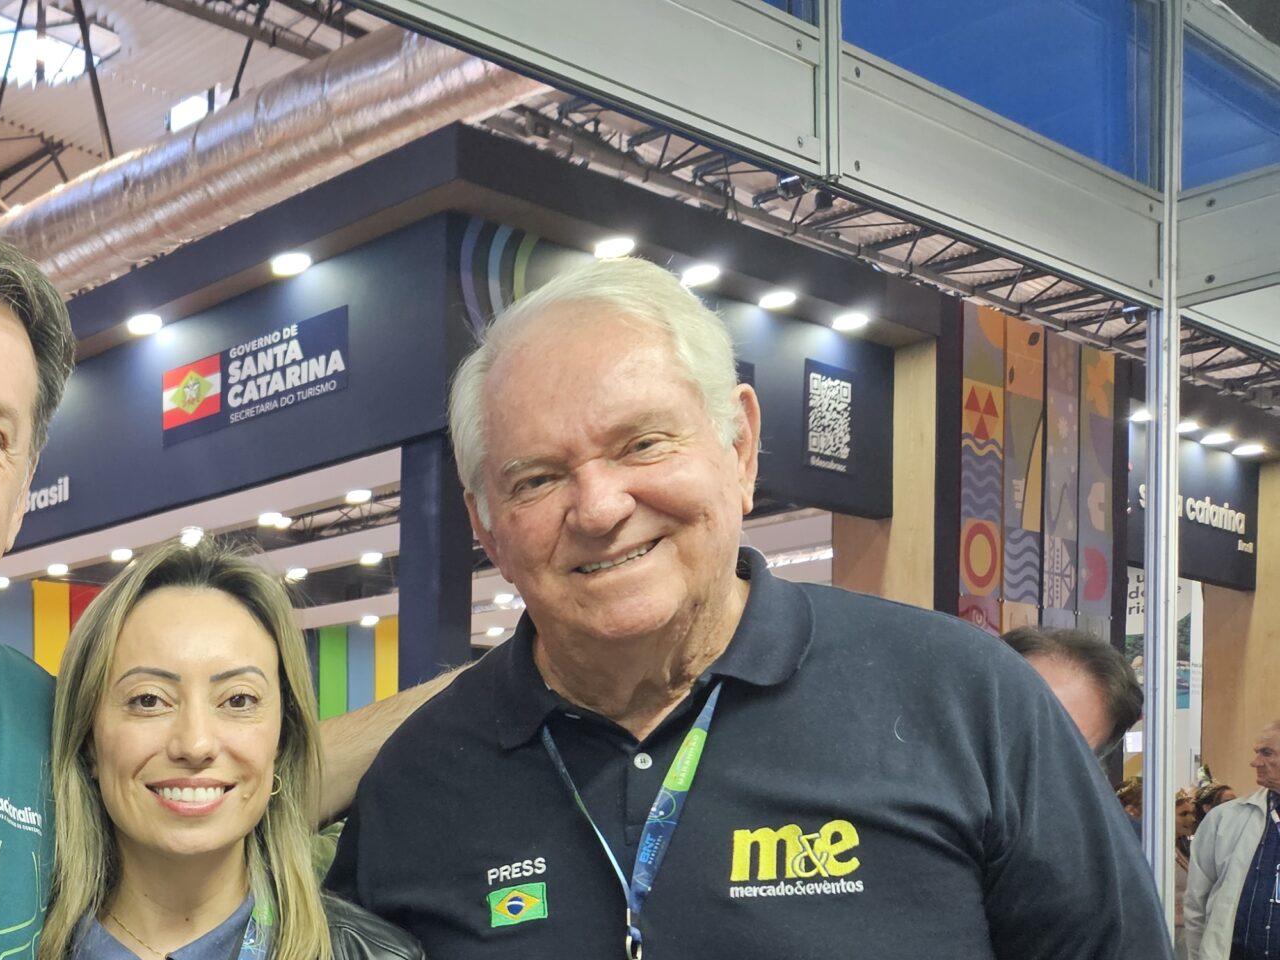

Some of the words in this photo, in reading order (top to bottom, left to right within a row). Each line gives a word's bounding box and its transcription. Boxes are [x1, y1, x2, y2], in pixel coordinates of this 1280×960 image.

[227, 339, 304, 384] SANTA
[229, 331, 281, 358] GOVERNO
[282, 324, 298, 340] DE
[227, 349, 346, 408] CATARINA
[229, 400, 278, 424] SECRETARIA
[280, 394, 295, 407] DO
[296, 379, 337, 401] TURISMO
[1186, 496, 1246, 535] catarina
[487, 856, 547, 885] PRESS
[730, 819, 861, 882] m&e
[729, 877, 864, 898] mercado&eventos
